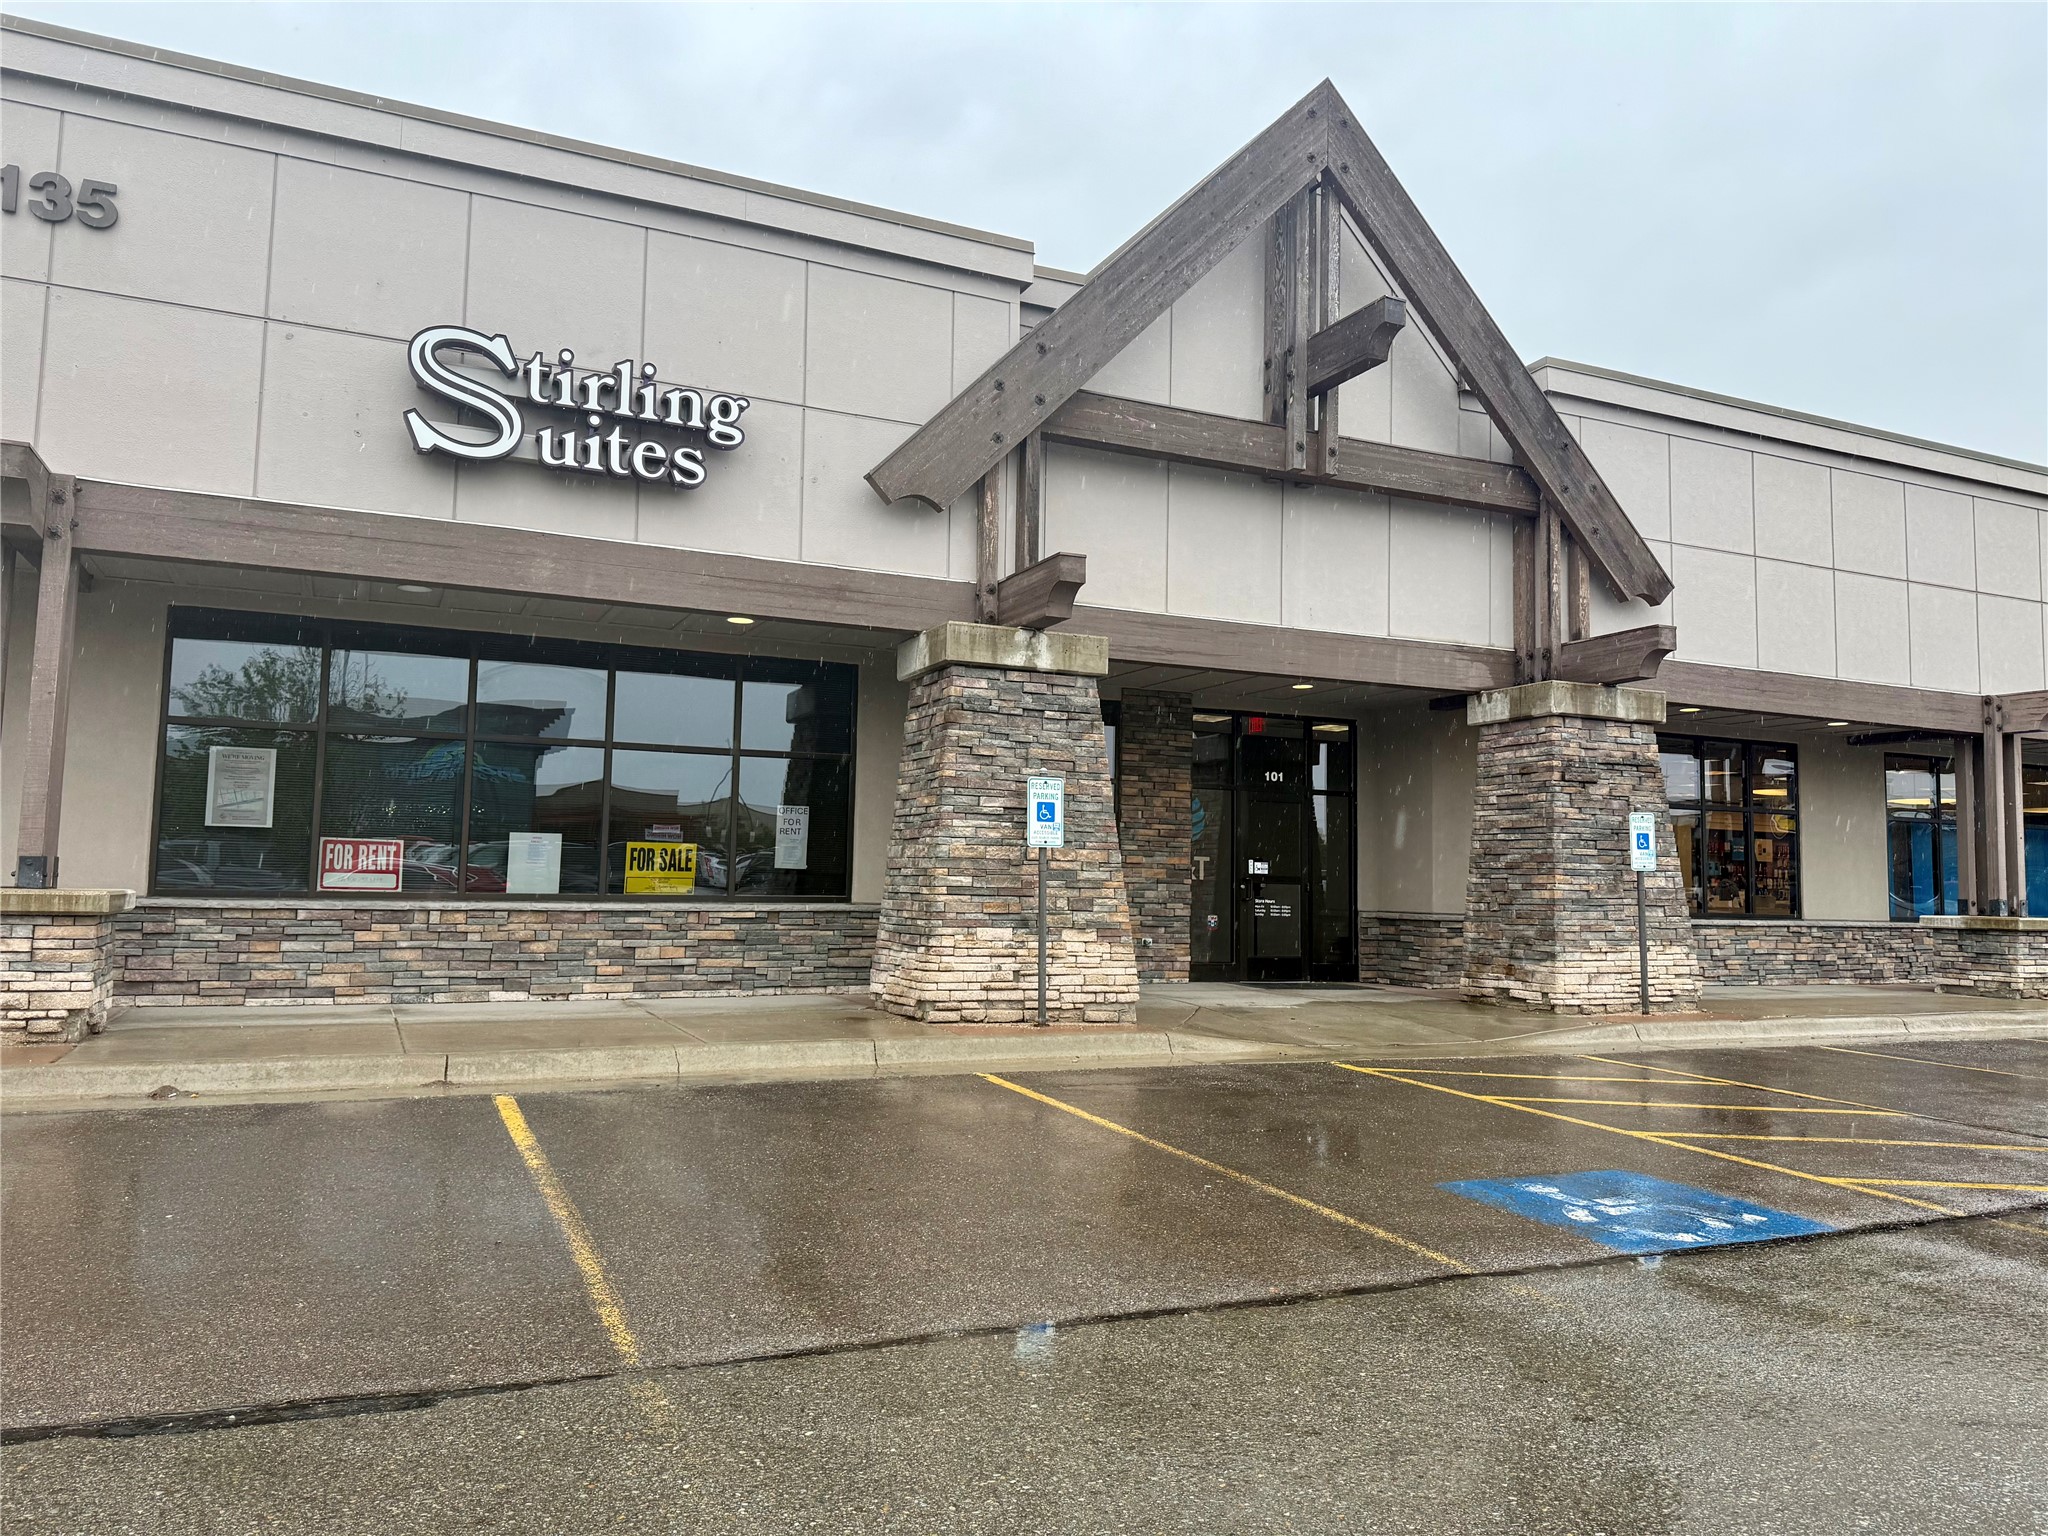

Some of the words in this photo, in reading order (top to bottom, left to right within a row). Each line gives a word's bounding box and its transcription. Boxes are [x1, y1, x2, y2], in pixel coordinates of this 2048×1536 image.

[0, 164, 119, 230] 135
[403, 324, 750, 460] Stirling
[1265, 771, 1284, 782] 101
[1031, 782, 1060, 791] RESERVED
[1032, 792, 1059, 801] PARKING
[778, 806, 809, 815] OFFICE
[783, 818, 802, 826] FOR
[779, 827, 802, 836] RENT
[325, 843, 354, 870] FOR
[358, 844, 397, 871] RENT
[629, 847, 656, 872] FOR
[659, 848, 694, 873] SALE
